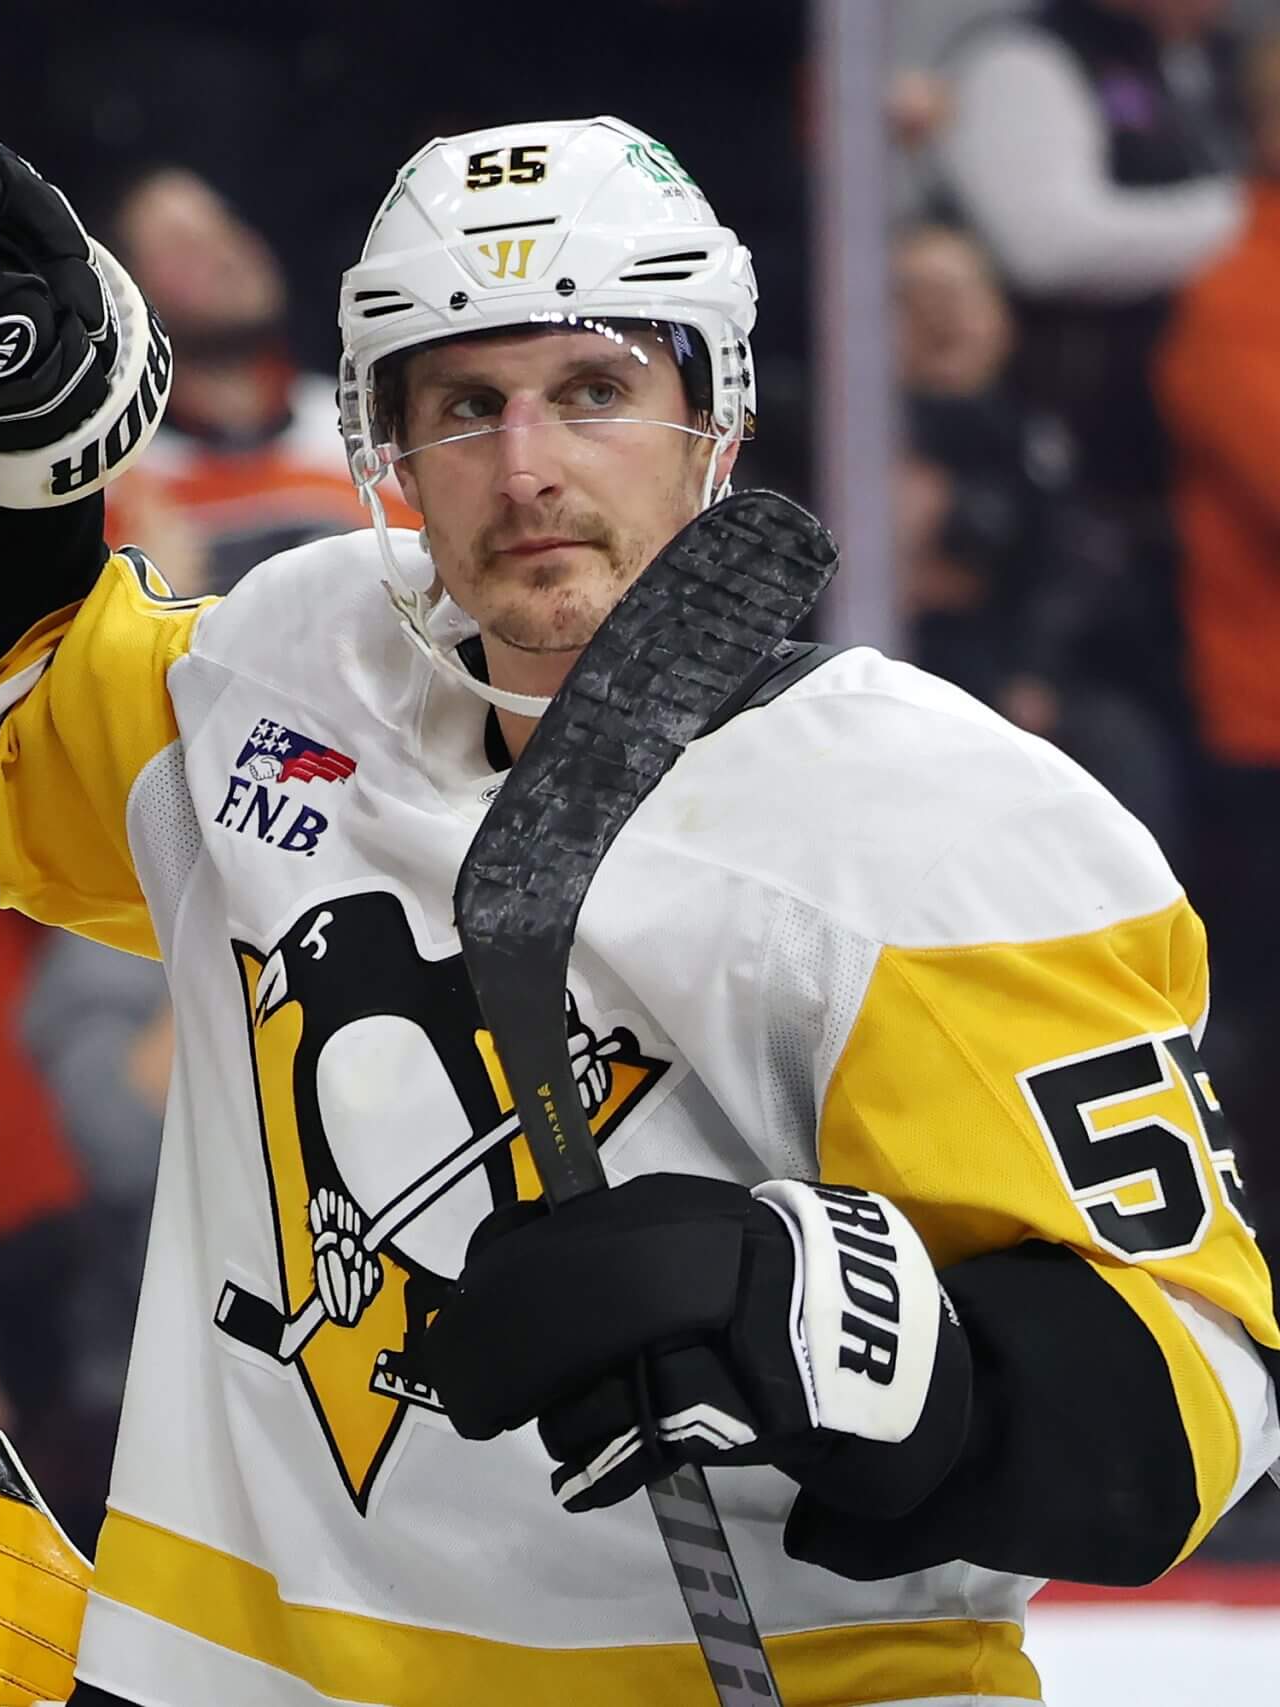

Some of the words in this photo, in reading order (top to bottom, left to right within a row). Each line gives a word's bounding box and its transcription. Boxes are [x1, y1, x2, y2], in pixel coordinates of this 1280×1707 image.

[466, 144, 551, 192] 55
[51, 306, 172, 495] RIOR
[214, 775, 329, 857] F.N.B.
[804, 1183, 900, 1386] RIOR
